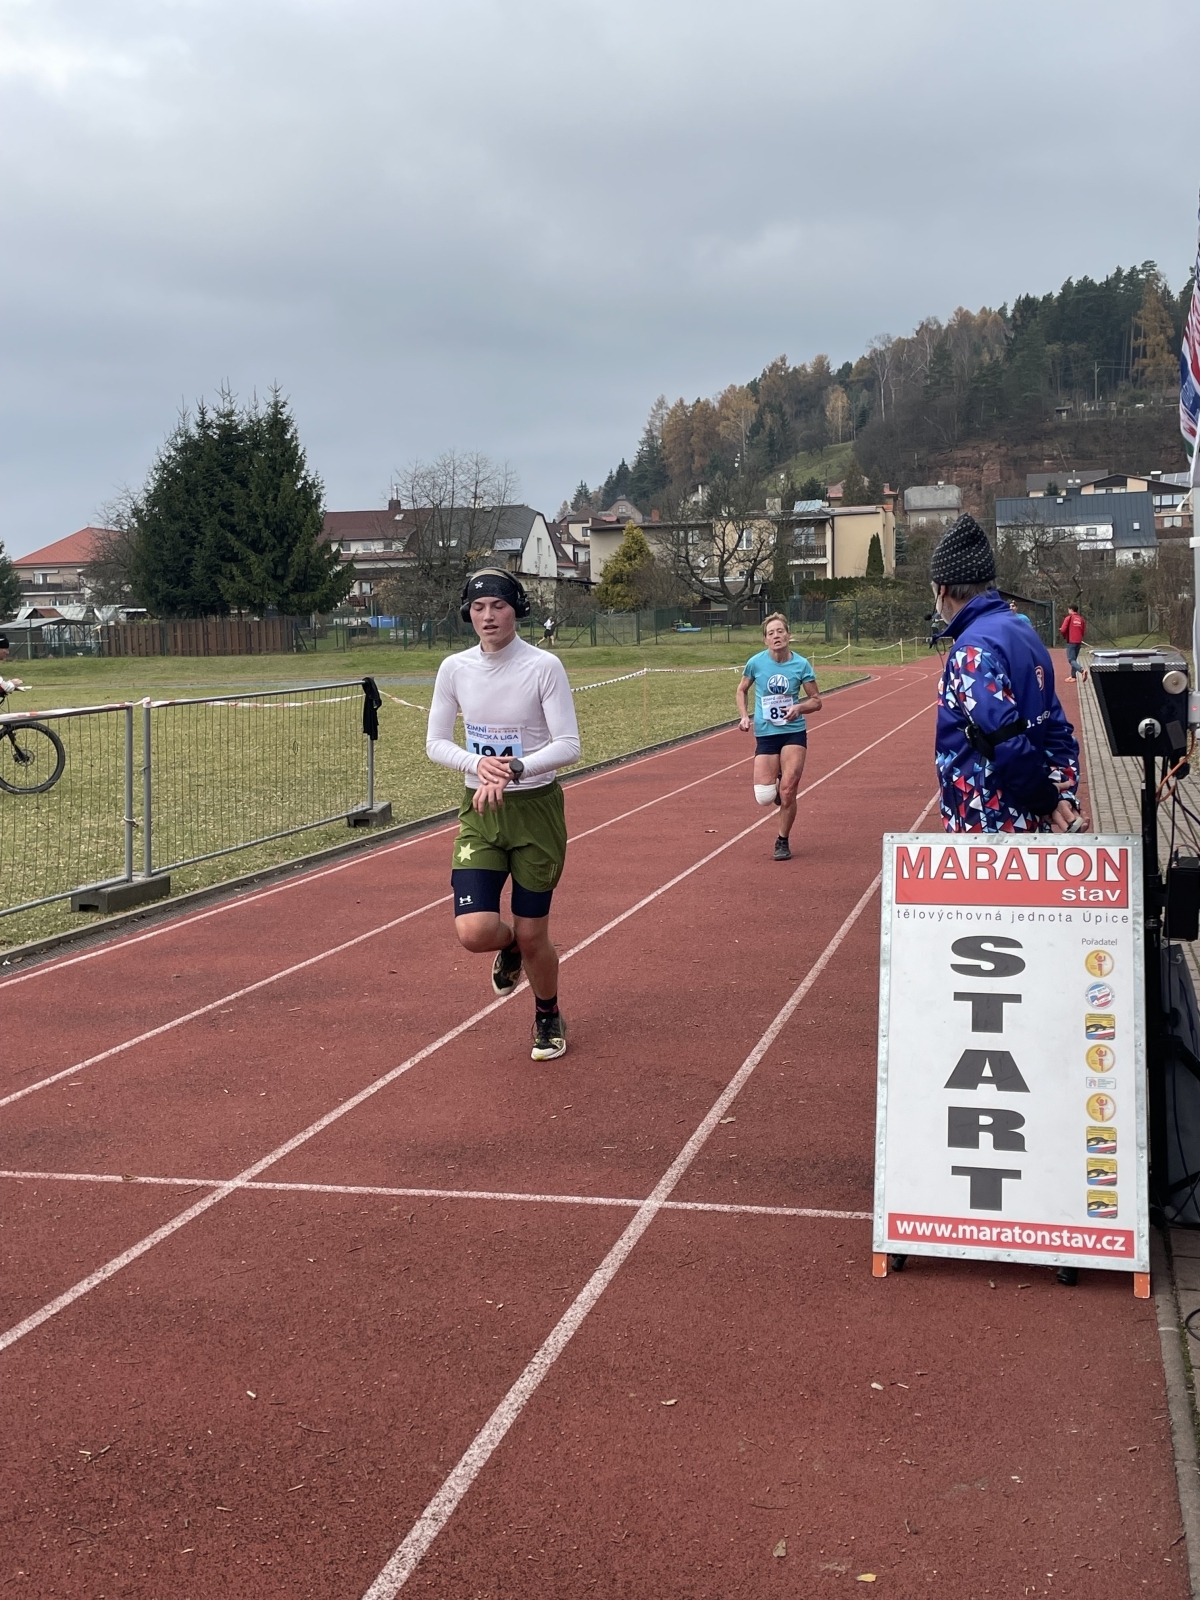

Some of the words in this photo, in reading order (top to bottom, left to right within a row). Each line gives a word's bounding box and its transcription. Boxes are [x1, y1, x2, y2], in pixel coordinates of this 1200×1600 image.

[896, 846, 1128, 882] MARATON
[1061, 886, 1121, 902] stav
[897, 908, 1002, 922] tělovýchovná
[1011, 910, 1073, 924] jednota
[1082, 910, 1129, 925] Úpice
[1081, 937, 1118, 946] Pořadatel
[943, 935, 1031, 1212] START
[896, 1219, 1126, 1251] www.maratonstav.cz
